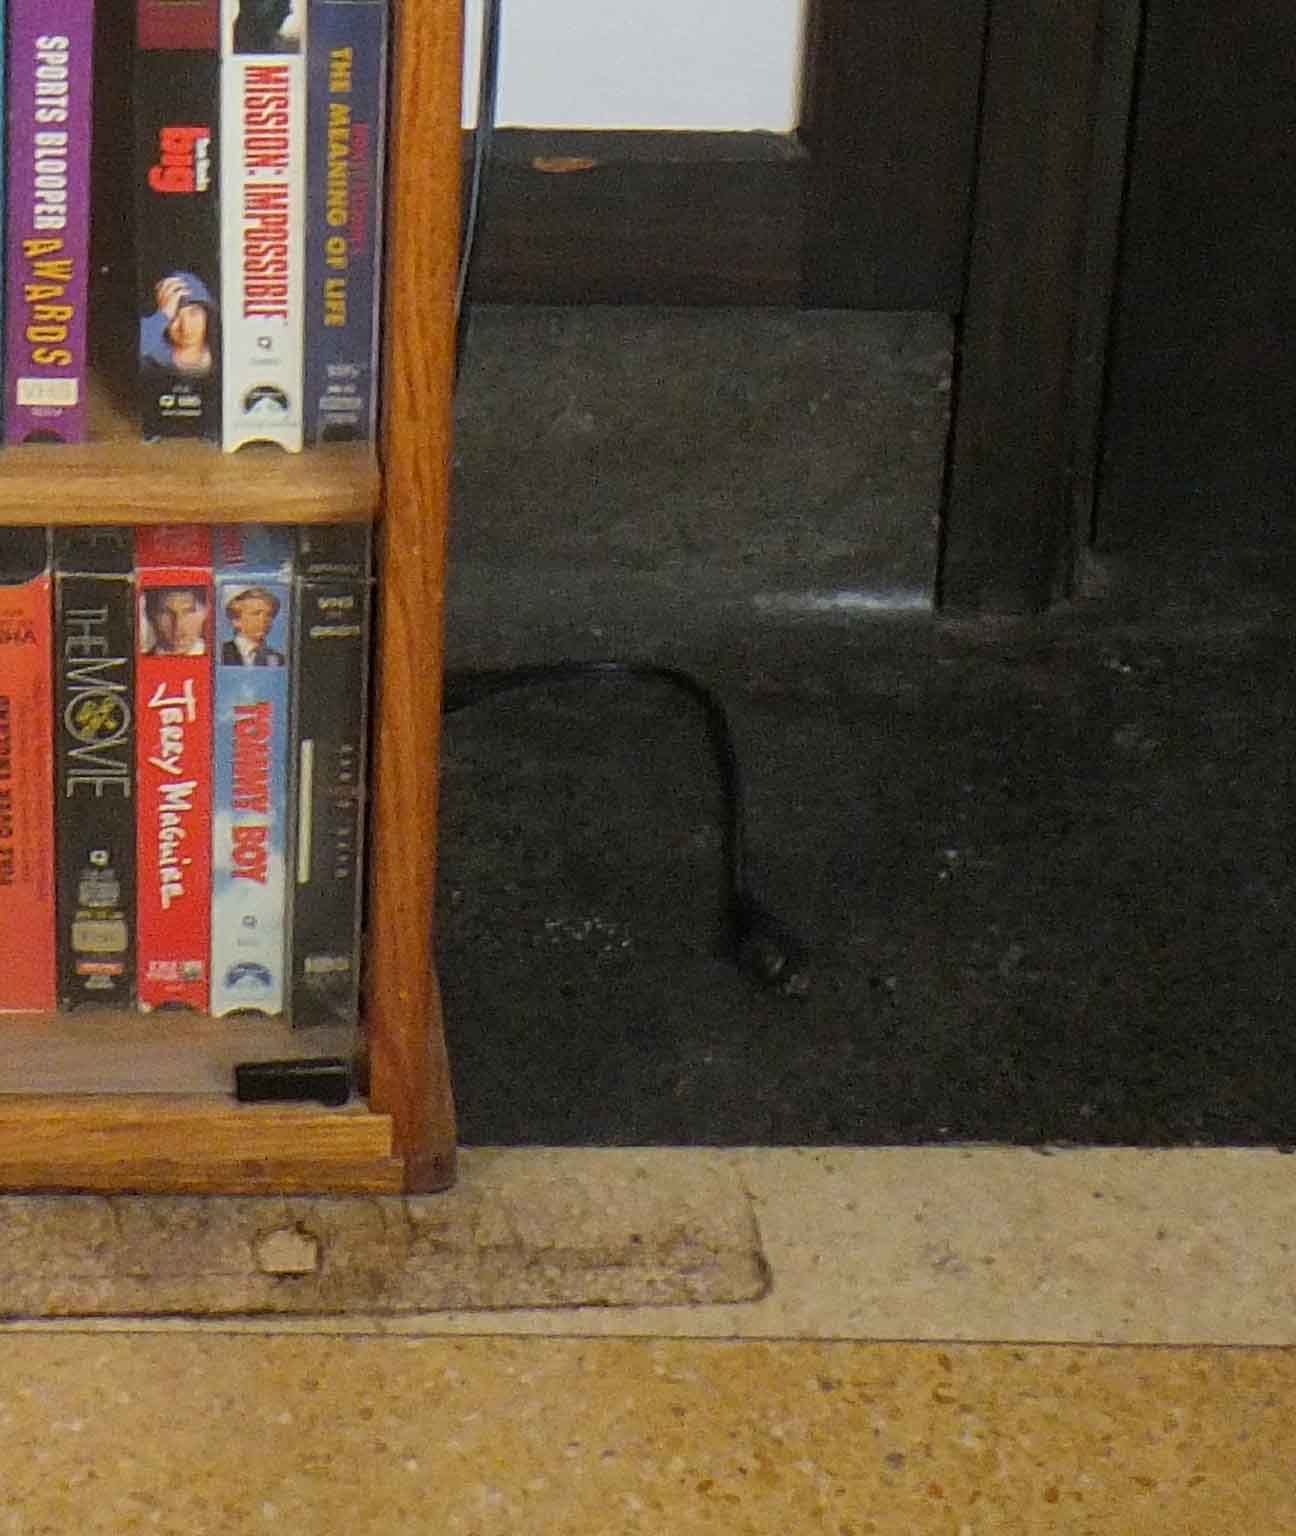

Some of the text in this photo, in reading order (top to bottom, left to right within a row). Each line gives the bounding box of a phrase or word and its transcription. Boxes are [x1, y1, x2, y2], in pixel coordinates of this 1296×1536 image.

[20, 34, 76, 367] SPORTS BLOOPER AWARDS
[242, 64, 290, 321] MISSION: IMPOSSIBLE
[323, 46, 353, 328] THE MEANING OF LIFE
[63, 608, 133, 798] THE MOVIE
[231, 699, 273, 886] TOMMY BOY
